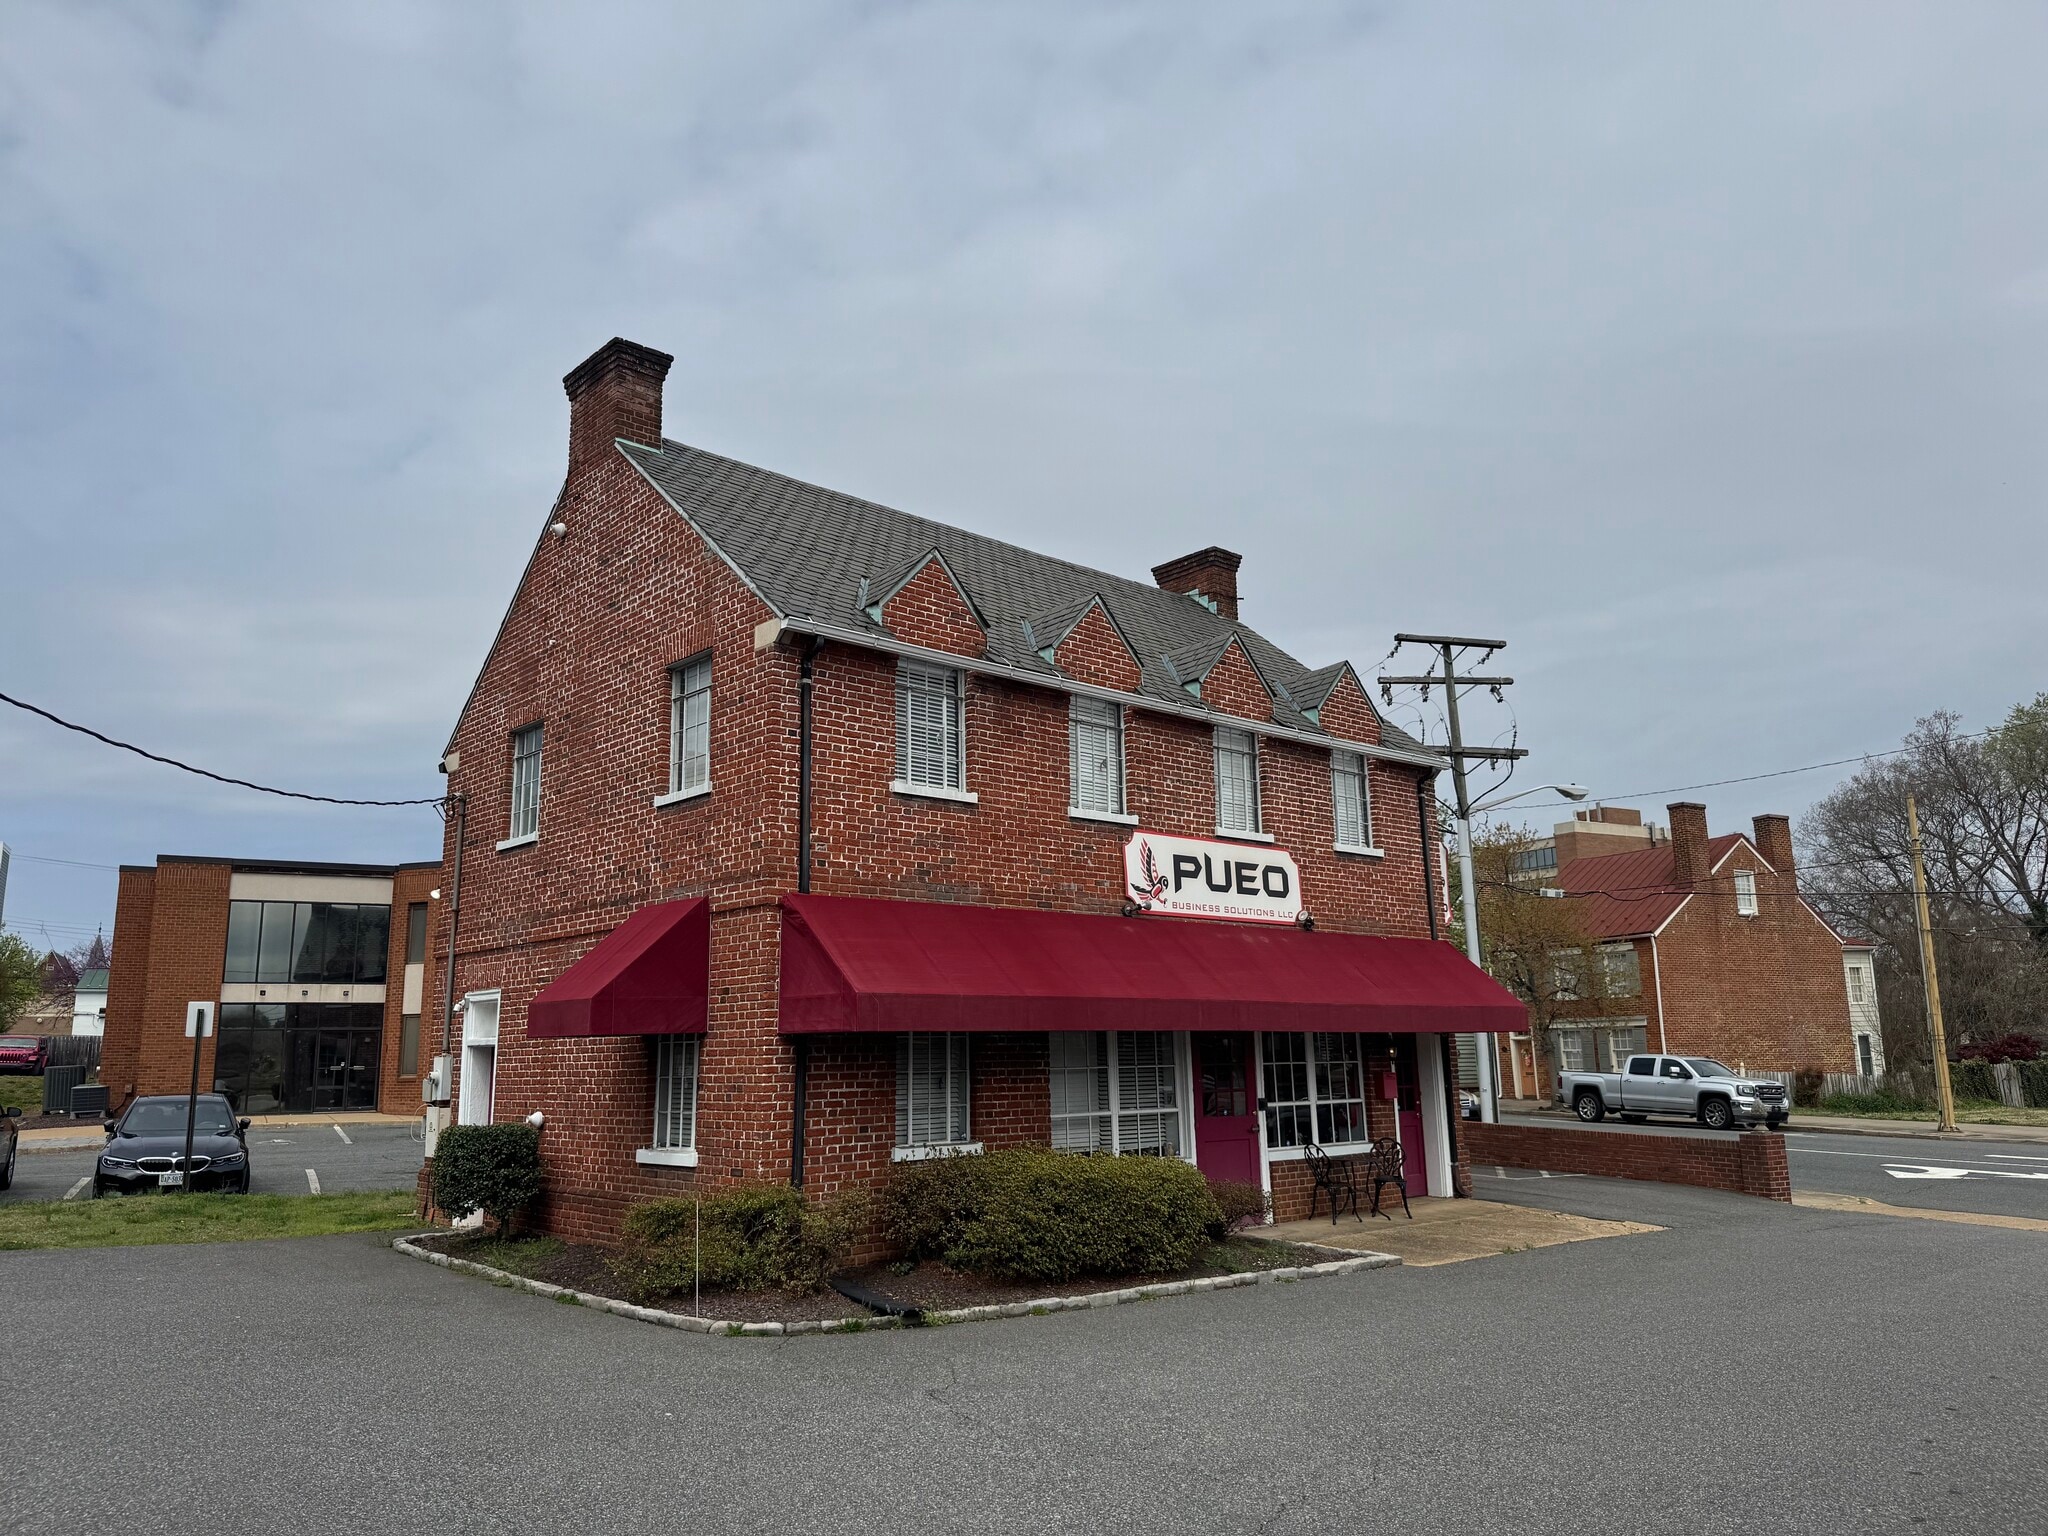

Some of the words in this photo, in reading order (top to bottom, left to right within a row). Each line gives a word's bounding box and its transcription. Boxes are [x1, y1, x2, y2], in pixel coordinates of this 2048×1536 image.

[1173, 853, 1289, 898] PUEO
[1171, 901, 1221, 913] BUSINESS
[1224, 906, 1275, 917] SOLUTIONS
[1277, 911, 1294, 919] LLC
